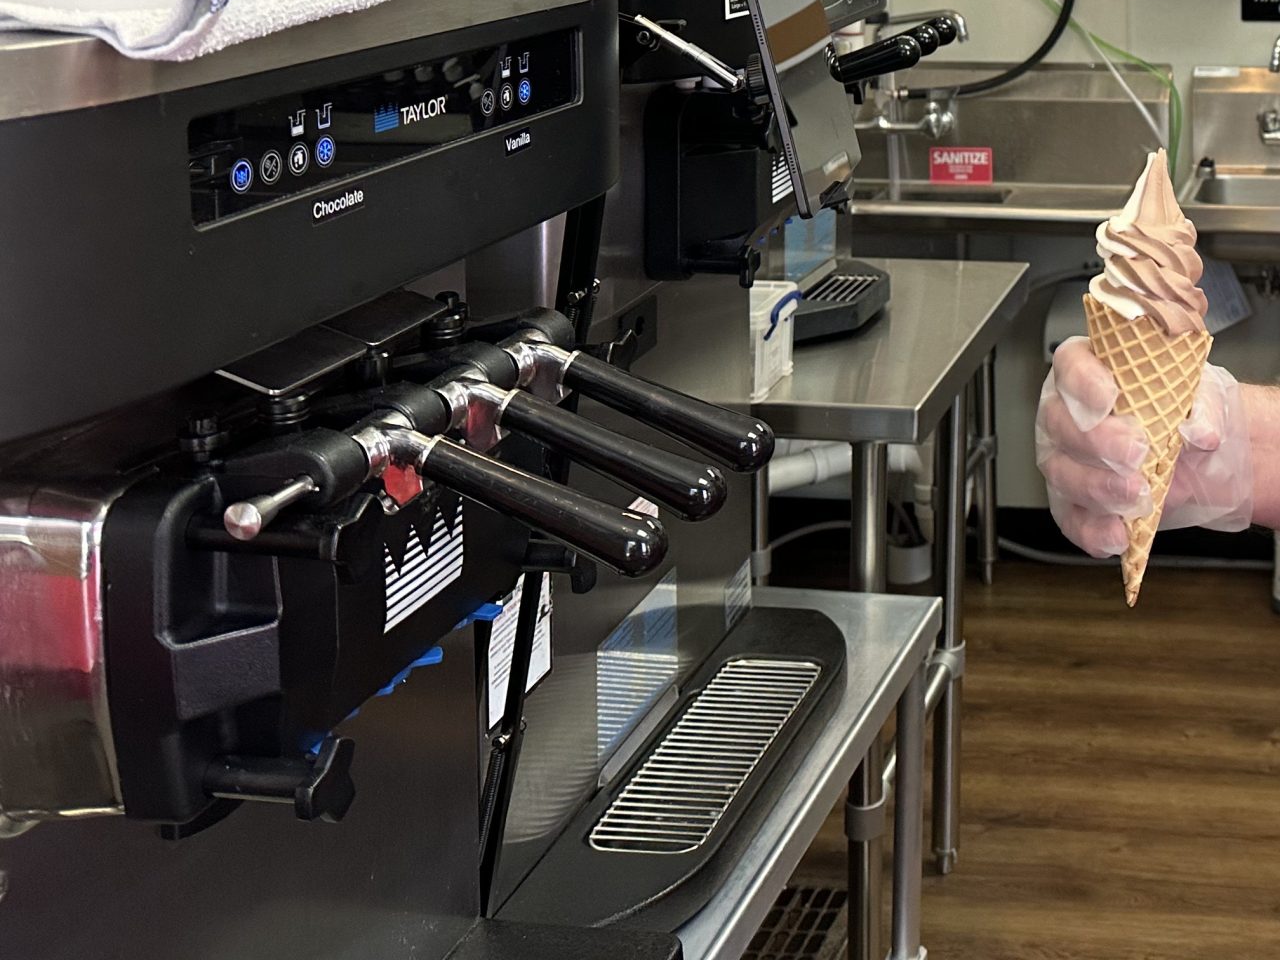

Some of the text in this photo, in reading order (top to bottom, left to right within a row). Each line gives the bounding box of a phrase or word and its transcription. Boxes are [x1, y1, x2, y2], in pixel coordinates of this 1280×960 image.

[400, 96, 447, 125] TAYLOR
[505, 132, 531, 152] Vanilla
[933, 150, 989, 165] SANITIZE
[312, 189, 364, 220] Chocolate
